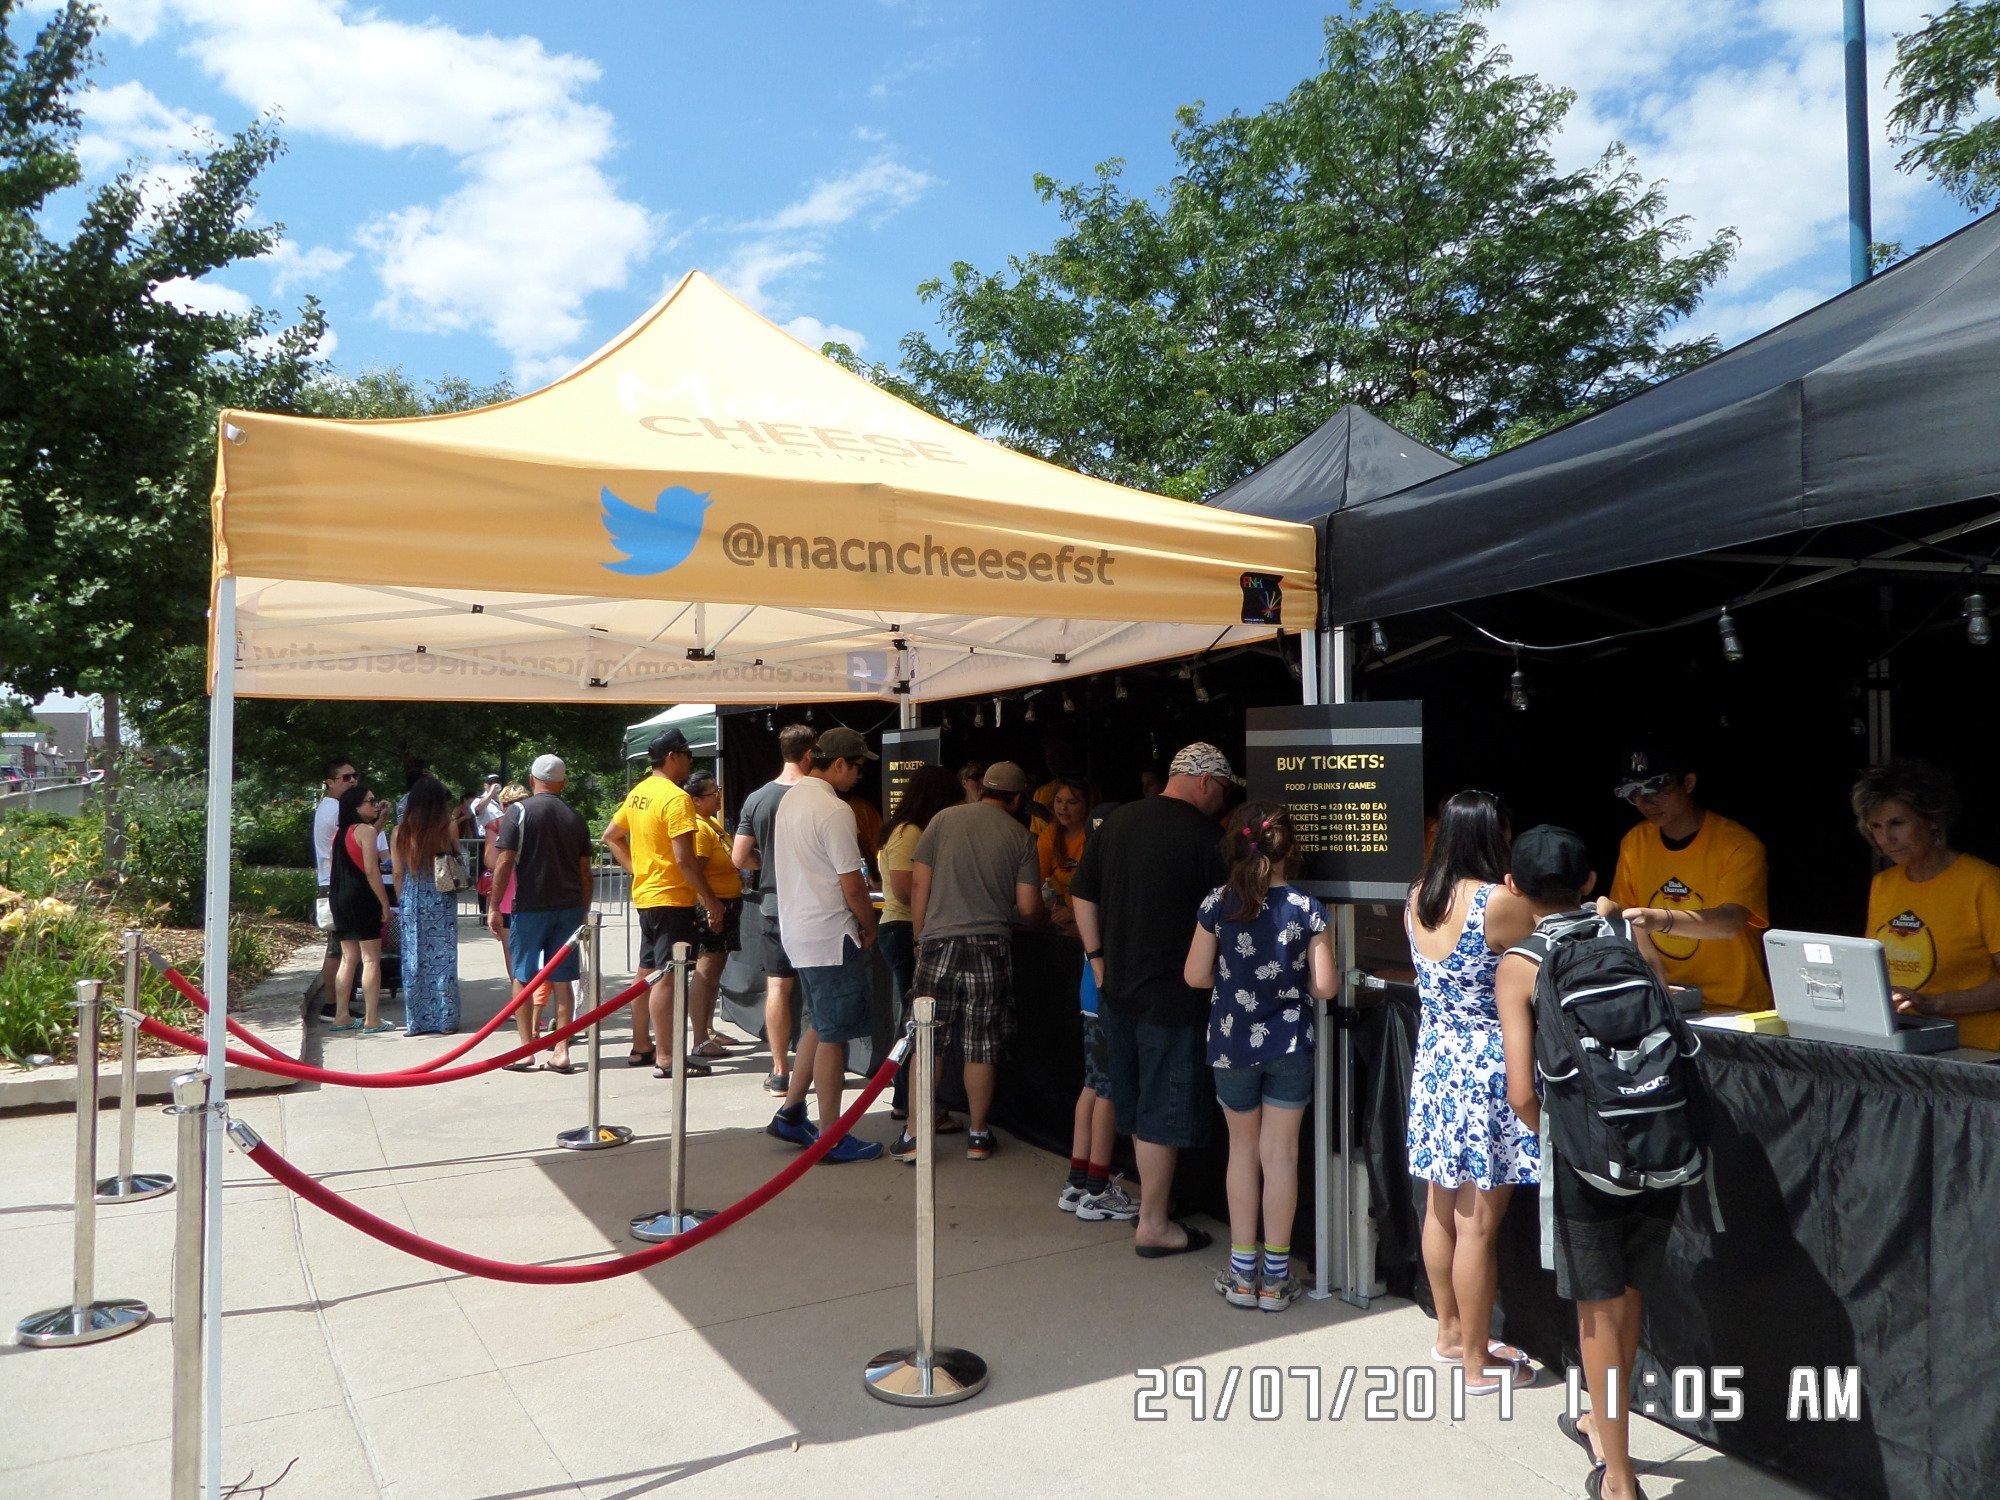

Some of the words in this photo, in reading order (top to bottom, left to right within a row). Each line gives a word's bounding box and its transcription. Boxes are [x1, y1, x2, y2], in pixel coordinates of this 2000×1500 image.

[639, 404, 968, 466] CHEESE
[721, 521, 1116, 588] @macncheesefst
[889, 762, 899, 771] BUY
[1277, 757, 1306, 771] BUY
[1311, 754, 1385, 770] TICKETS:
[1329, 803, 1342, 811] $20
